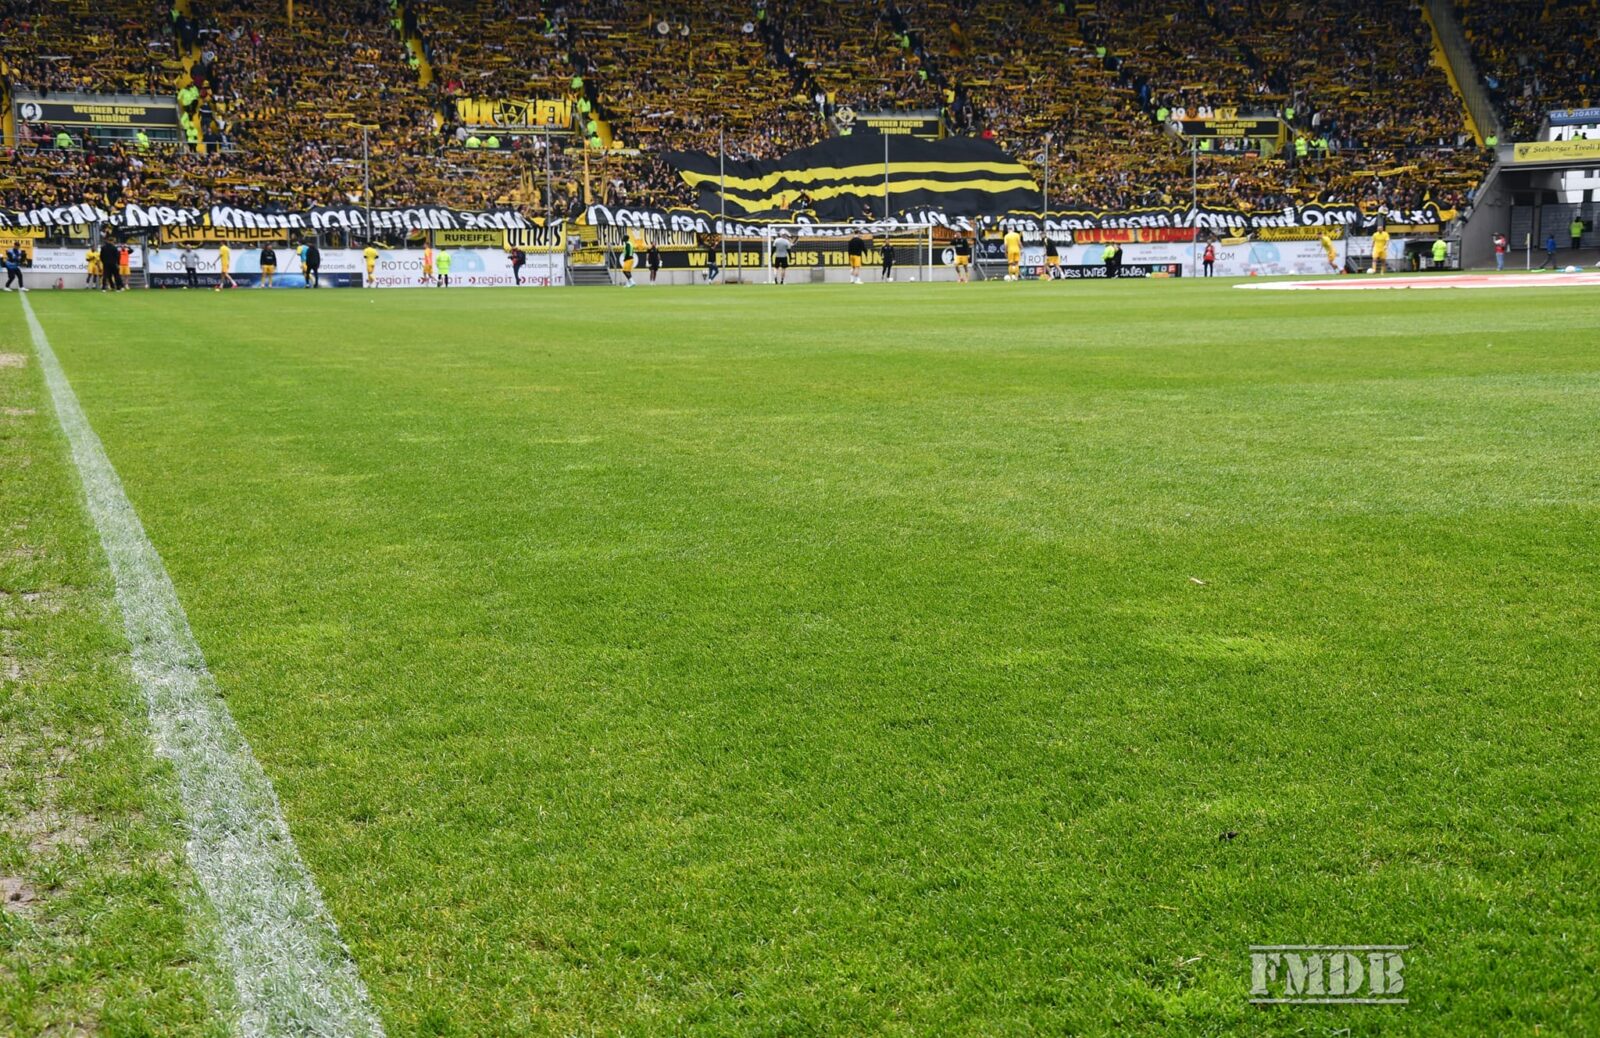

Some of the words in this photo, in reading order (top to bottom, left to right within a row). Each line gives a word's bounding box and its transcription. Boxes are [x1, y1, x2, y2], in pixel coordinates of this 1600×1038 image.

[73, 106, 113, 115] WERNER
[115, 106, 146, 115] FUCHS
[90, 114, 131, 122] TRIBÜNE
[444, 233, 496, 242] RUREIFEL
[688, 252, 760, 266] WRNER
